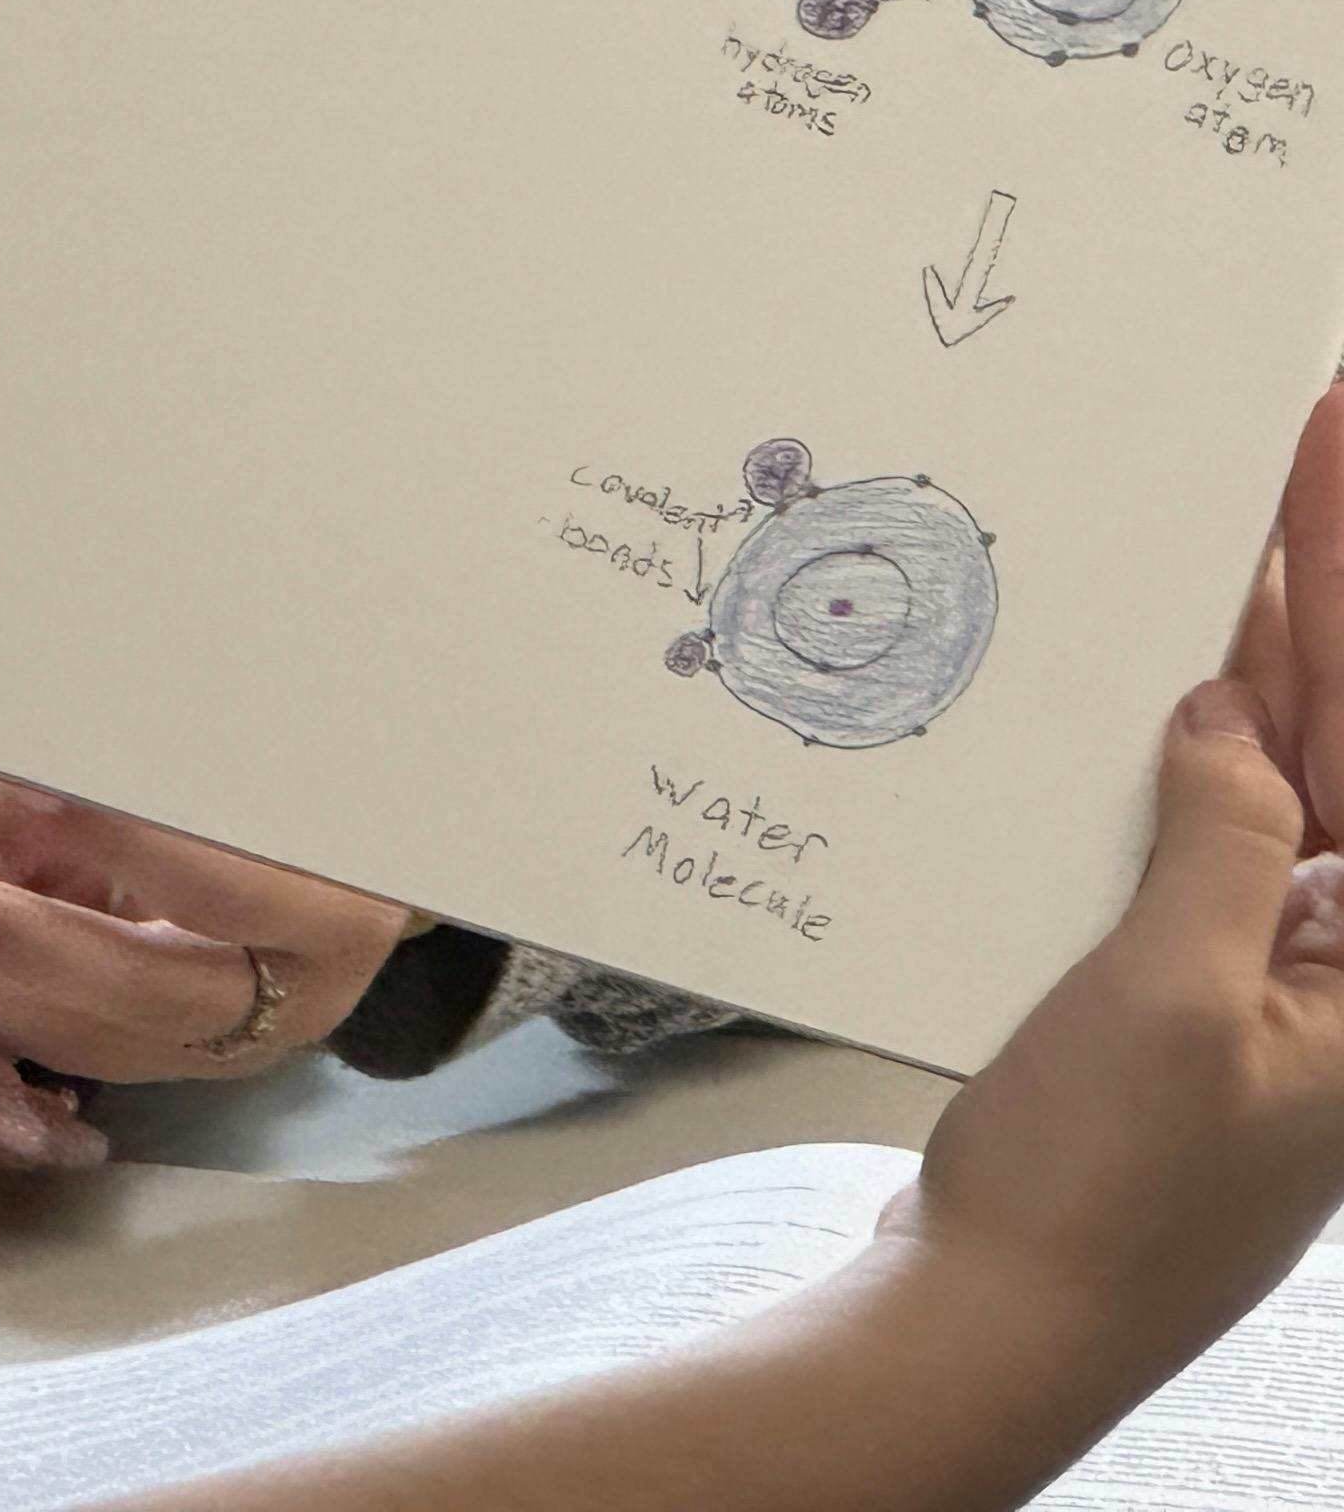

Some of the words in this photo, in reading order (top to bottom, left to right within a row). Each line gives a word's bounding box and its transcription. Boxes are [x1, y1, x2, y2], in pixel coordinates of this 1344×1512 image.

[736, 80, 837, 136] atoms
[1184, 102, 1288, 168] atom
[560, 512, 674, 588] bonds
